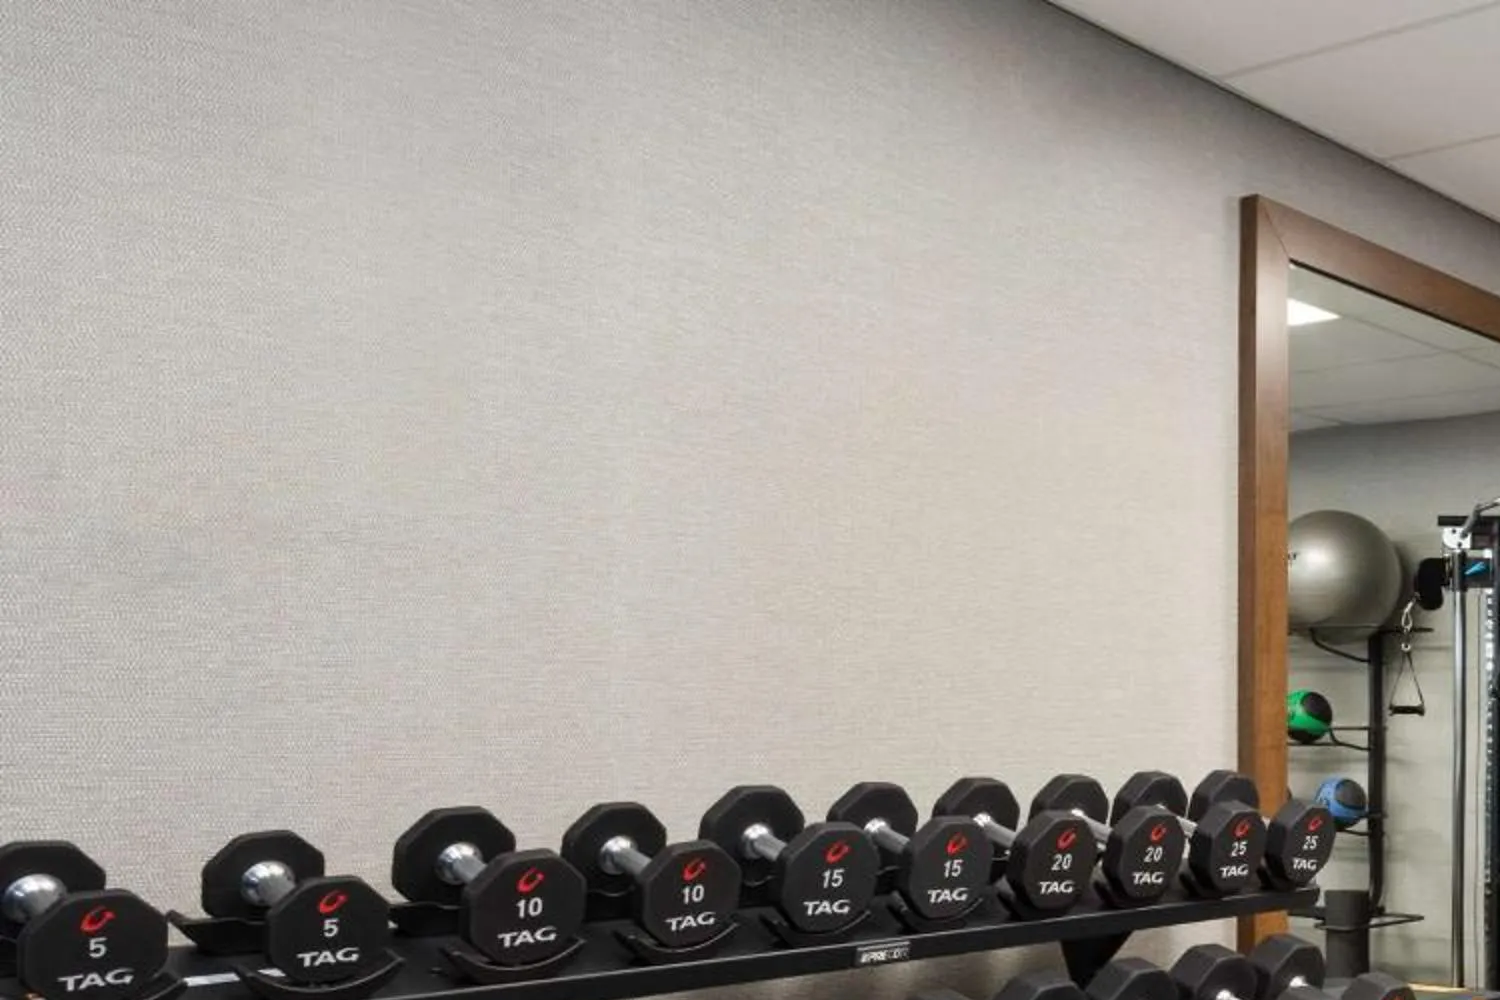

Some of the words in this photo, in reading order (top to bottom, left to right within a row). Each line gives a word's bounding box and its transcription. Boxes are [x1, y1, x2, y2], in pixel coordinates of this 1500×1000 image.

[1230, 840, 1248, 857] 25
[1302, 835, 1319, 851] 25
[1050, 853, 1073, 871] 20
[1143, 845, 1163, 863] 20
[943, 858, 963, 878] 15
[1219, 863, 1249, 878] TAG
[1292, 857, 1317, 871] TAG
[823, 868, 845, 889] 15
[1039, 880, 1074, 895] TAG
[1132, 871, 1164, 885] TAG
[682, 884, 705, 905] 10
[927, 887, 968, 904] TAG
[516, 896, 543, 919] 10
[803, 899, 850, 916] TAG
[323, 918, 339, 938] 5
[665, 911, 716, 932] TAG
[497, 926, 557, 948] TAG
[89, 936, 107, 959] 5
[297, 947, 359, 968] TAG
[58, 968, 134, 992] TAG
